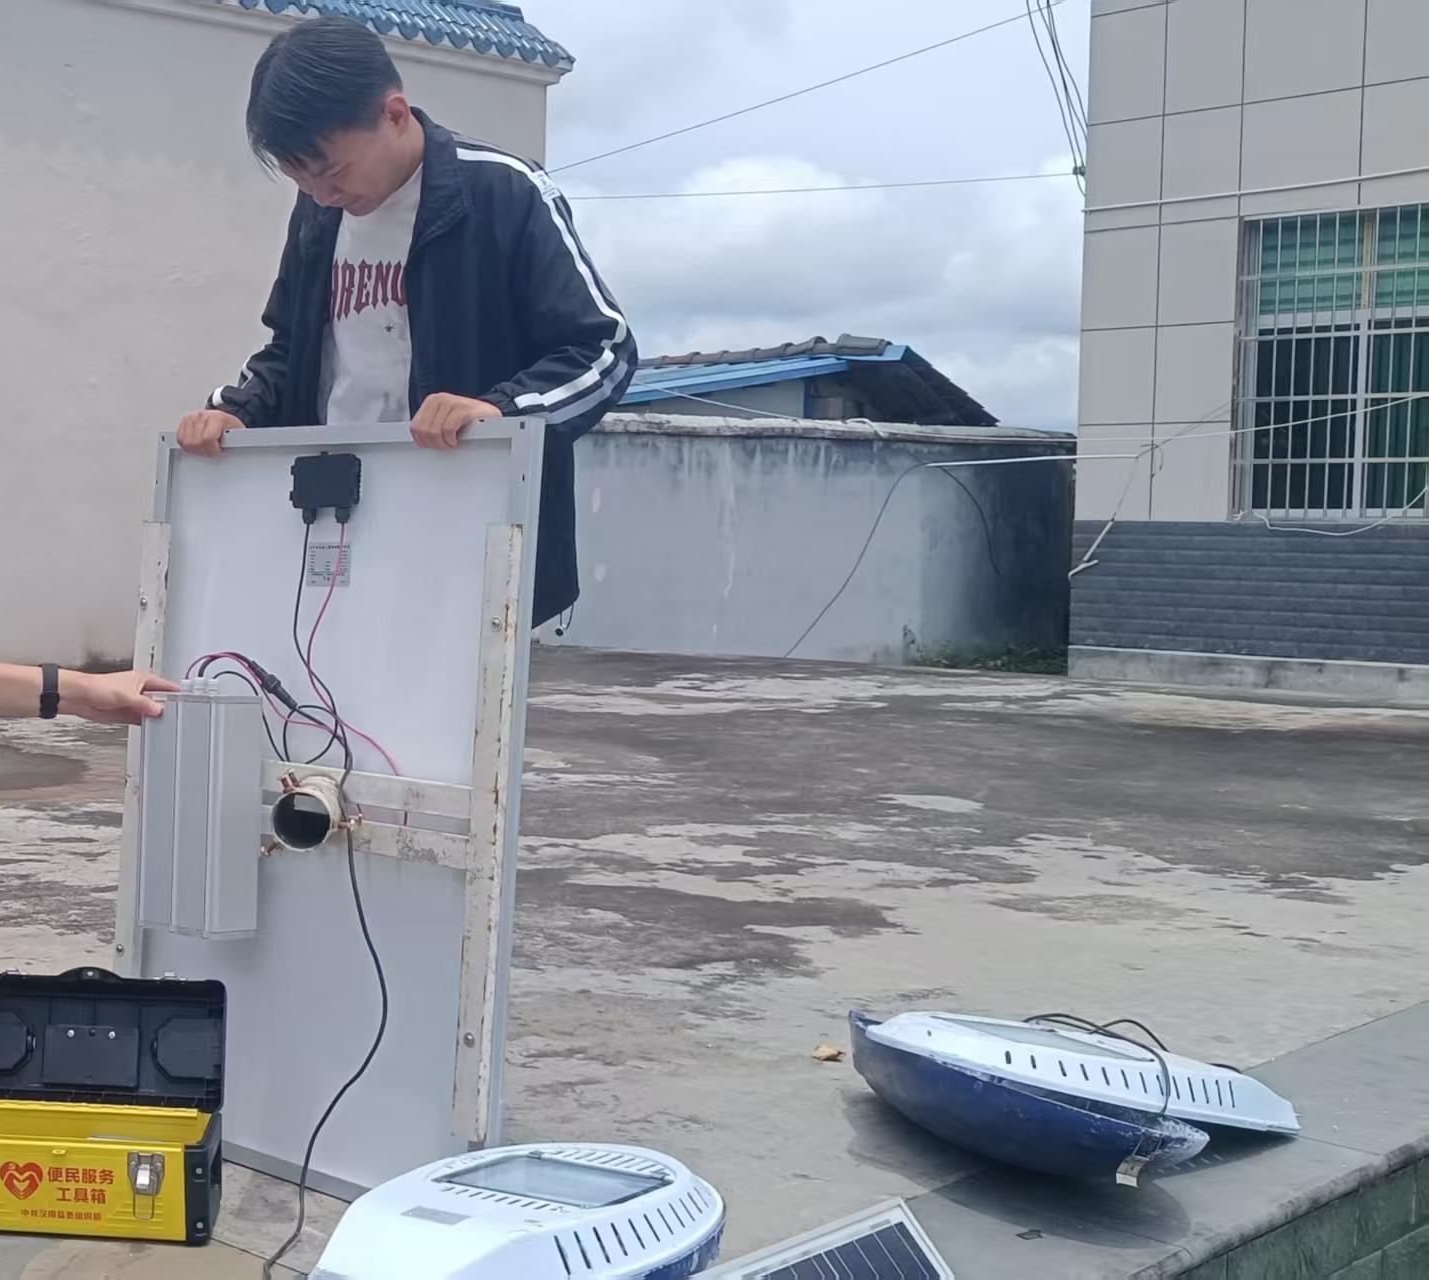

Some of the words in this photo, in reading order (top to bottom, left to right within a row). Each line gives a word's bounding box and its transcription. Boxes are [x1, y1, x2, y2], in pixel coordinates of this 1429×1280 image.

[47, 1166, 115, 1185] 便民服务
[56, 1187, 106, 1204] 工具箱
